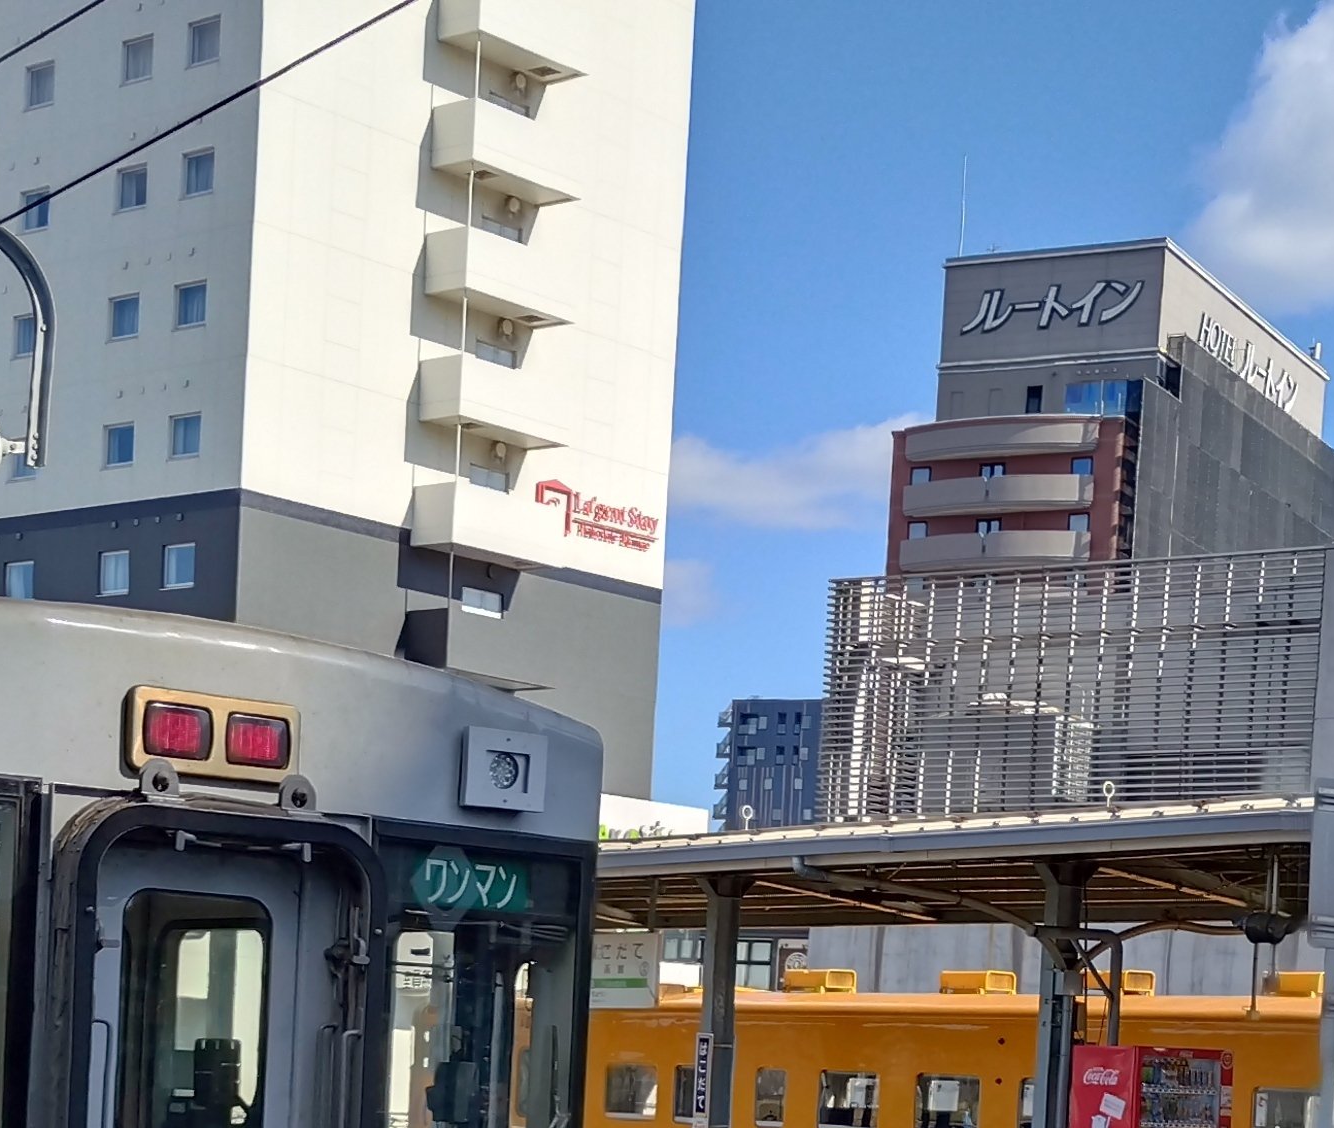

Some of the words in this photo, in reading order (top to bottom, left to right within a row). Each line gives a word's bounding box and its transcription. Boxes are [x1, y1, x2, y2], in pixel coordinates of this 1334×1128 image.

[960, 280, 1145, 335] ルートイン
[1198, 312, 1236, 367] HOTEL
[628, 507, 659, 535] Stay
[425, 858, 517, 909] ワンマン
